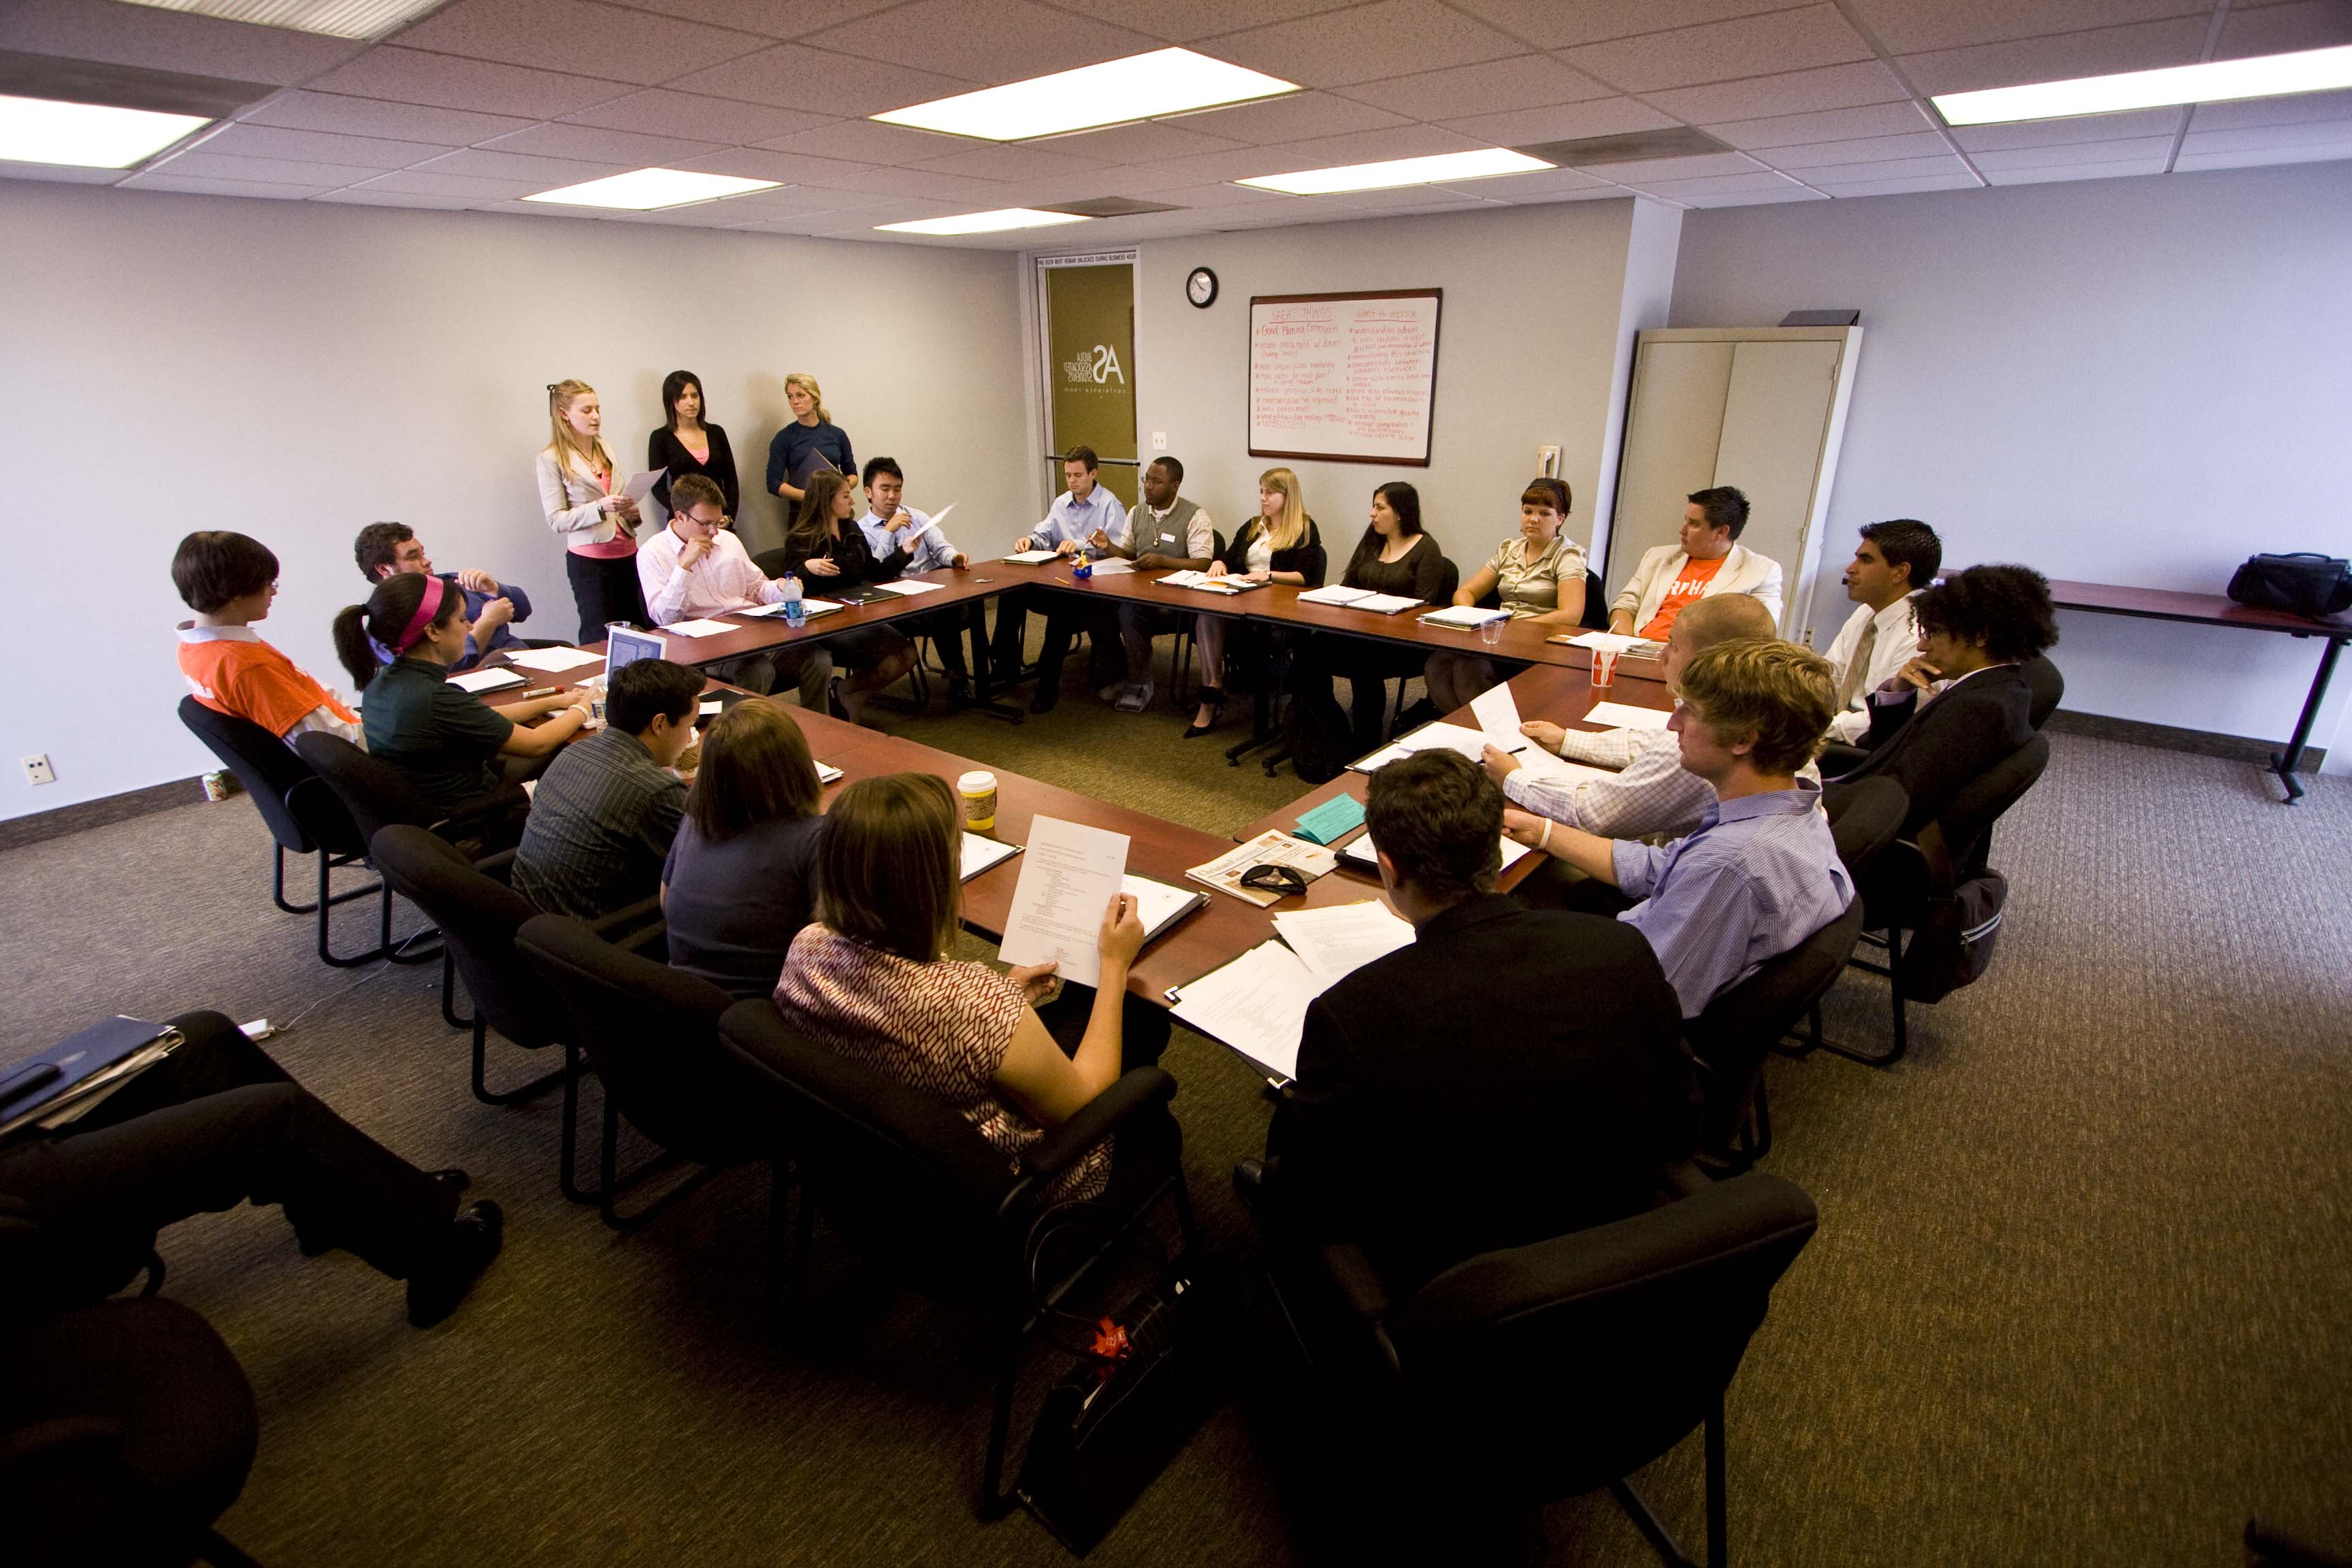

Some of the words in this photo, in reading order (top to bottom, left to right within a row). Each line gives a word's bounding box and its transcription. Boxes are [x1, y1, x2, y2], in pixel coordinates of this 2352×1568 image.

[1077, 255, 1095, 263] UNLOCKED
[1109, 253, 1126, 261] BUSINESS
[1301, 305, 1333, 319] THINGS
[1261, 324, 1279, 336] Good
